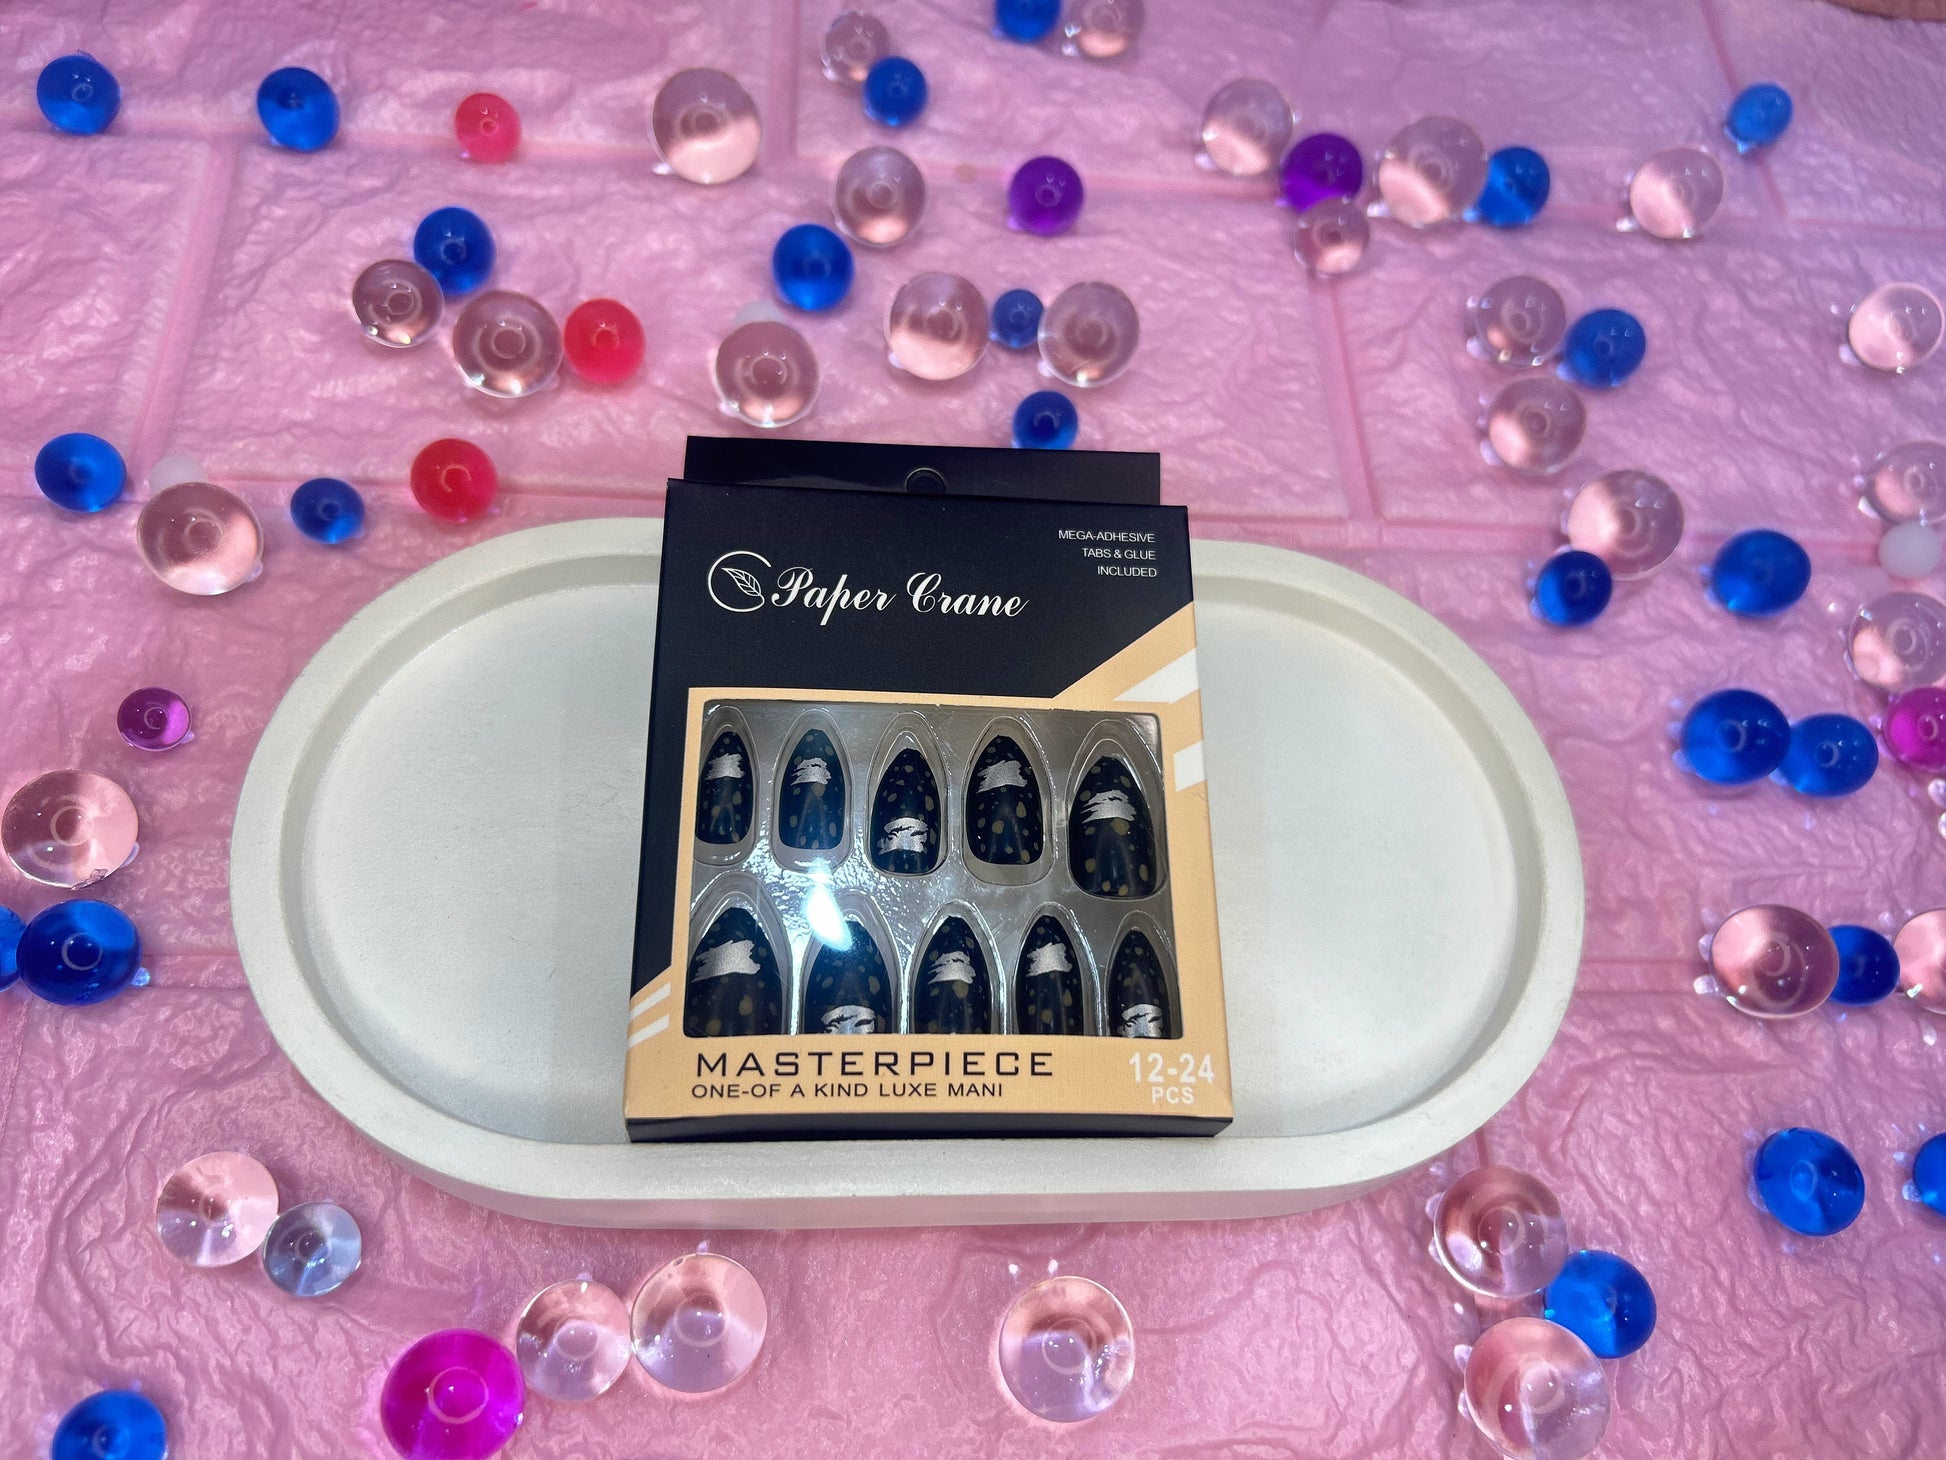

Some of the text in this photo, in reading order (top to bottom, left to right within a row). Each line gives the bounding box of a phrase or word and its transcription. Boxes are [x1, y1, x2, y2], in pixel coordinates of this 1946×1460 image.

[1058, 529, 1155, 543] MEGA-ADHESIVE
[1082, 547, 1156, 561] TABS & GLUE
[1097, 566, 1157, 578] INCLUDED
[771, 566, 1029, 626] Paper Crane
[697, 1051, 1054, 1077] MASTERPIECE
[1128, 1052, 1215, 1084] 12-24
[691, 1083, 1002, 1099] ONE-OF A KIND LUXE MANI
[1151, 1086, 1195, 1105] PCS
